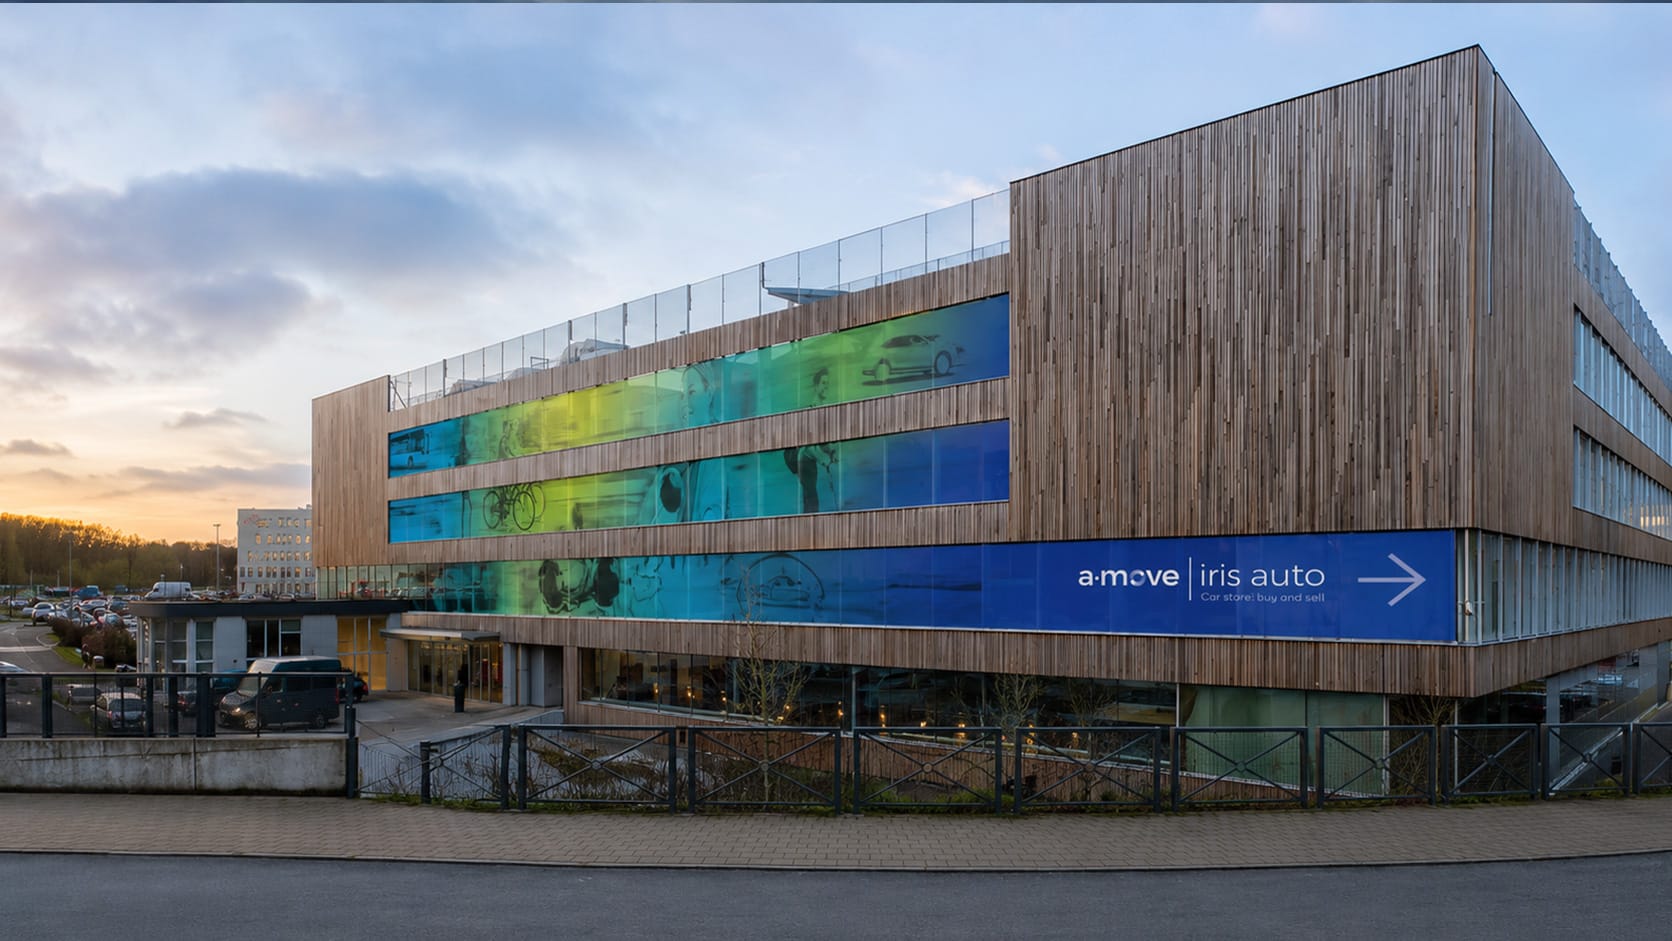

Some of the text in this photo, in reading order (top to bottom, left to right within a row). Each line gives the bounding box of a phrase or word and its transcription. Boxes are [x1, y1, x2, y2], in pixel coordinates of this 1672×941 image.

[1200, 563, 1326, 587] iris auto
[1200, 592, 1221, 602] Car
[1257, 592, 1278, 604] buy
[1280, 593, 1303, 602] and
[1305, 592, 1326, 603] sell
